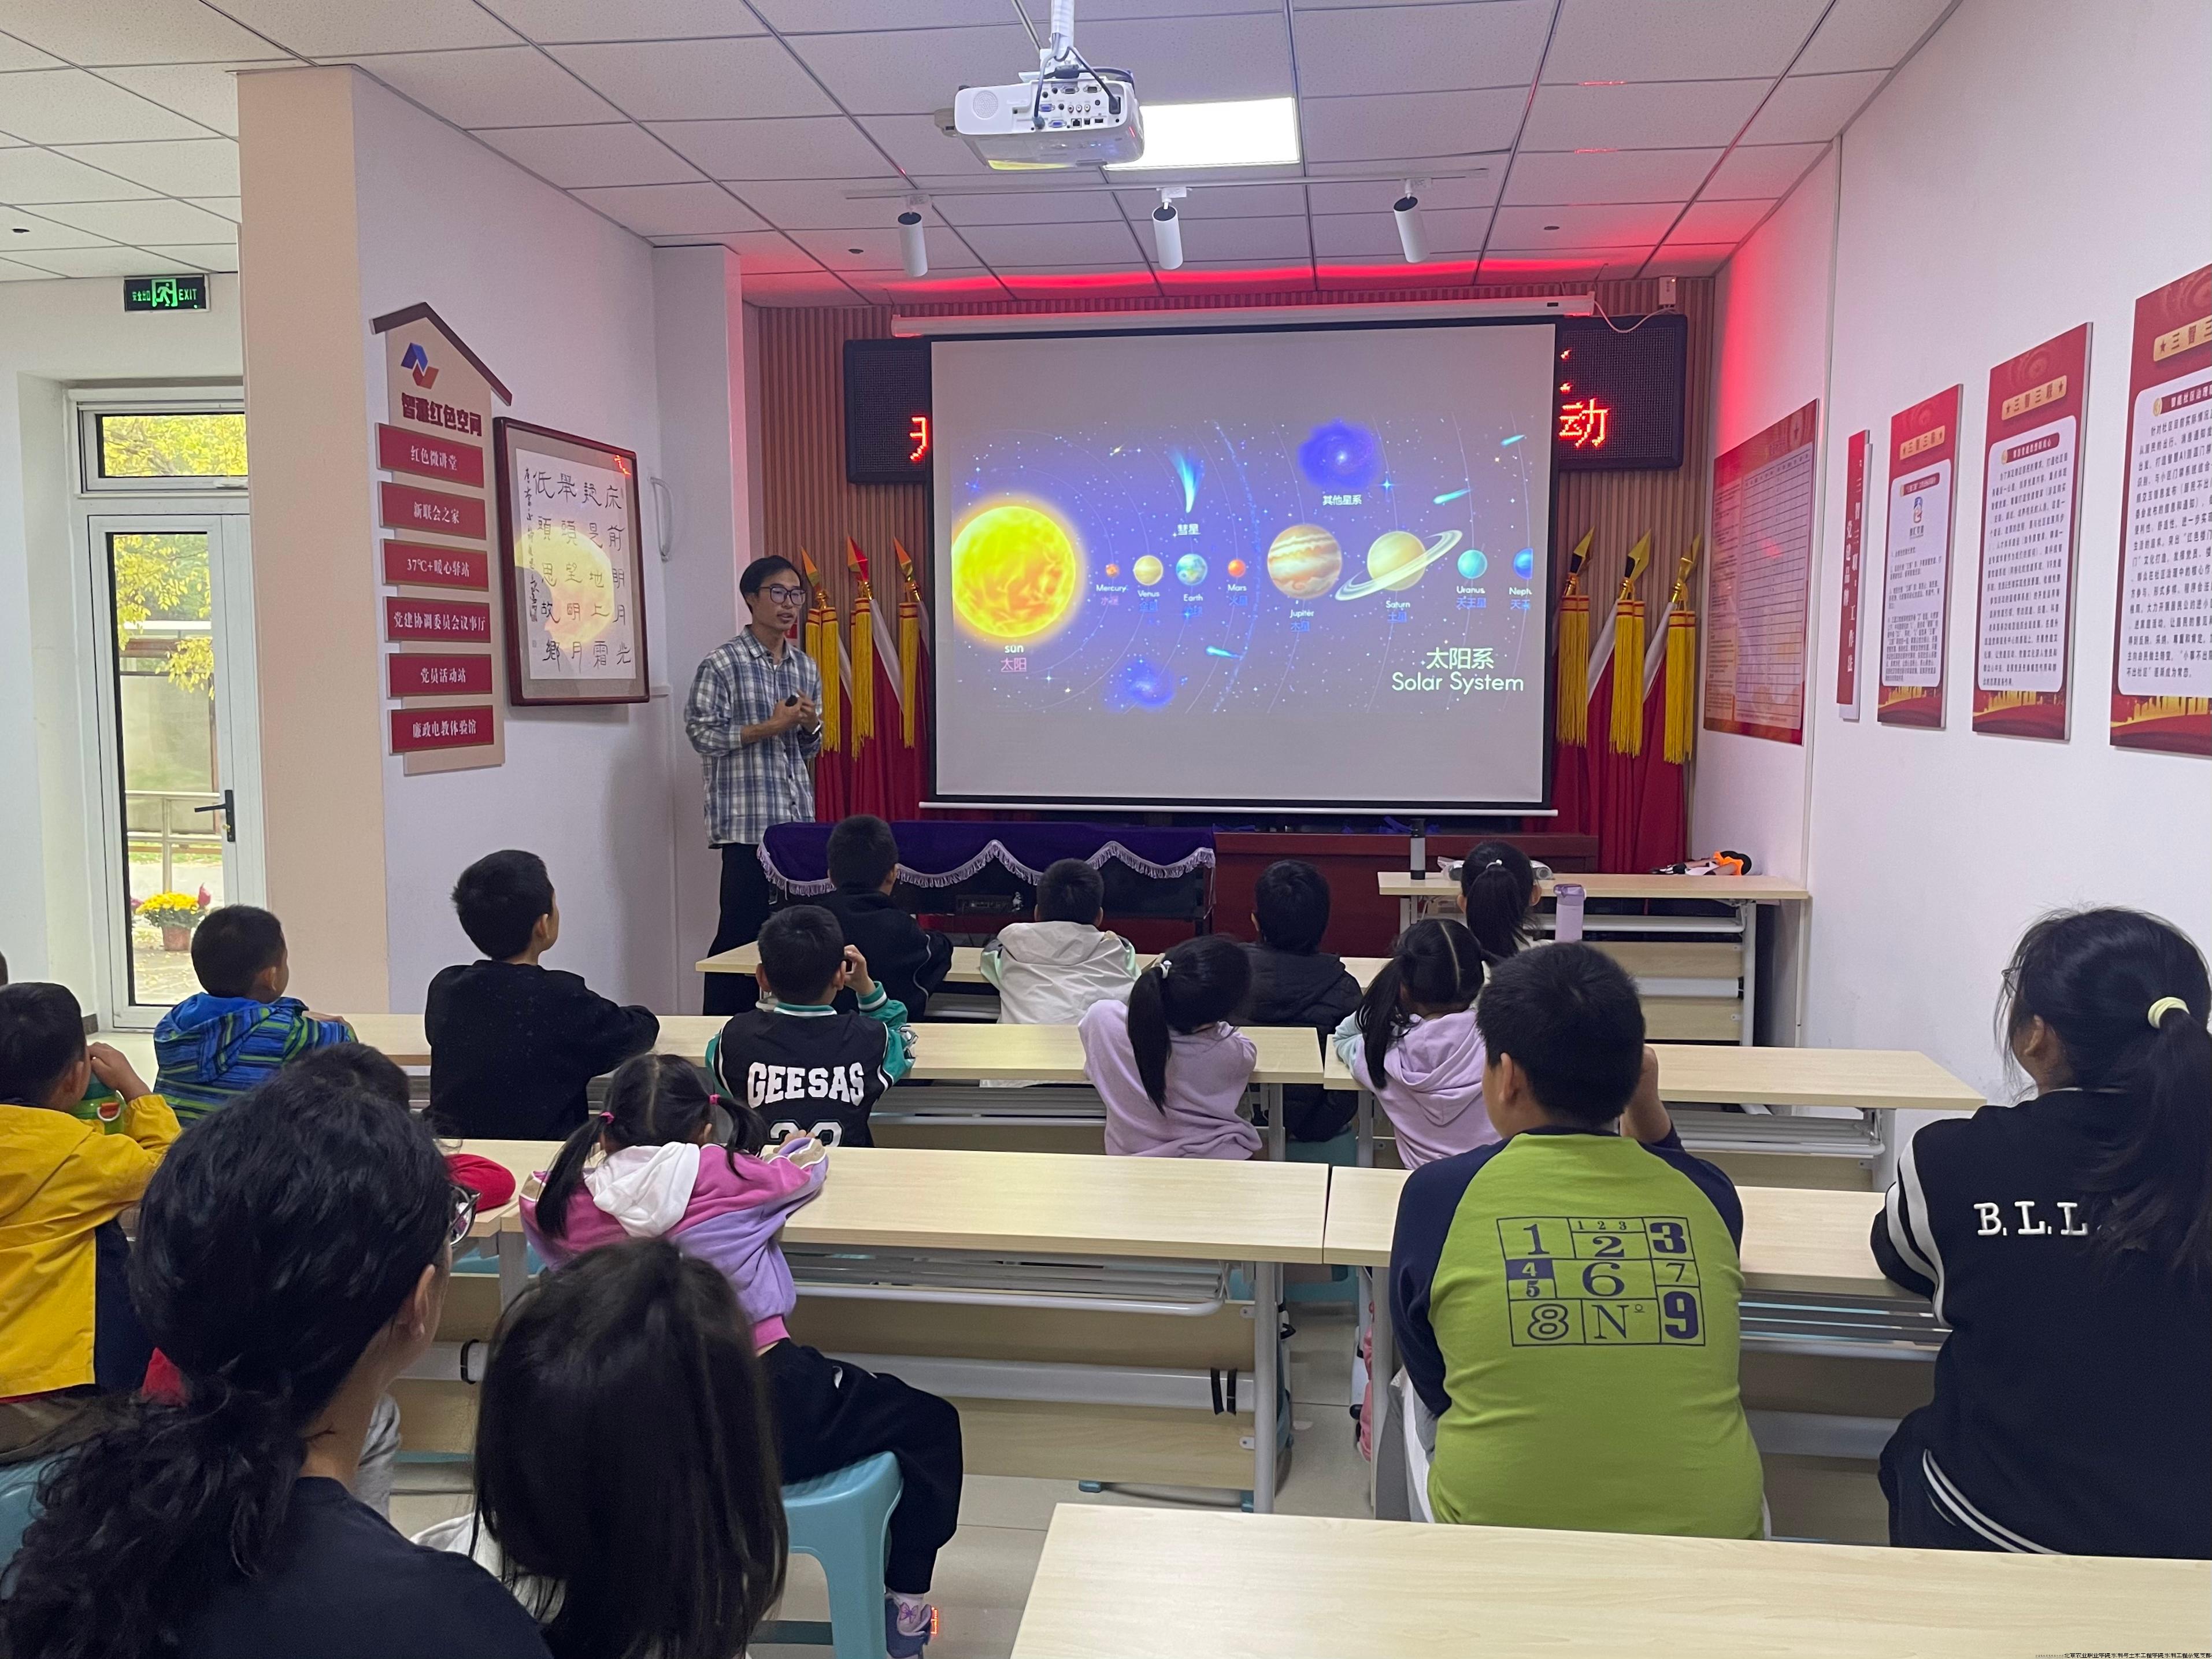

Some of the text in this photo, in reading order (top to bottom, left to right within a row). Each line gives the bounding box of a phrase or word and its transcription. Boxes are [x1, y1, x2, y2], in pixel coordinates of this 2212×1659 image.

[179, 288, 197, 301] EXIT
[1559, 398, 1609, 447] 动
[411, 445, 457, 471] 红色微讲堂
[1322, 494, 1362, 506] 其他星系
[414, 501, 460, 524] 新联会之家
[1096, 584, 1127, 592] Mercury
[1456, 586, 1485, 594] Uranus
[1183, 594, 1203, 602] Earth
[1385, 601, 1410, 609] Saturn
[394, 612, 486, 631] 党建协调委员会议事厅
[1290, 609, 1314, 618] Jupiter
[1005, 644, 1024, 653] sun
[1426, 647, 1494, 669] 太阳系
[1001, 657, 1027, 672] 太阳
[421, 668, 466, 683] 党员活动站
[1392, 671, 1524, 695] Solar System
[413, 719, 476, 738] 廉政电教体验馆
[747, 1062, 865, 1109] GEESAS
[1578, 1220, 1627, 1230] 1 2 3
[1523, 1224, 1550, 1255] 1
[1592, 1236, 1625, 1258] 2
[1650, 1222, 1687, 1254] 3
[1522, 1262, 1537, 1277] 4
[1665, 1262, 1686, 1283] 7
[1526, 1279, 1540, 1298] 5
[1582, 1262, 1625, 1297] 6
[1527, 1304, 1569, 1340] 8
[1663, 1291, 1699, 1340] 9
